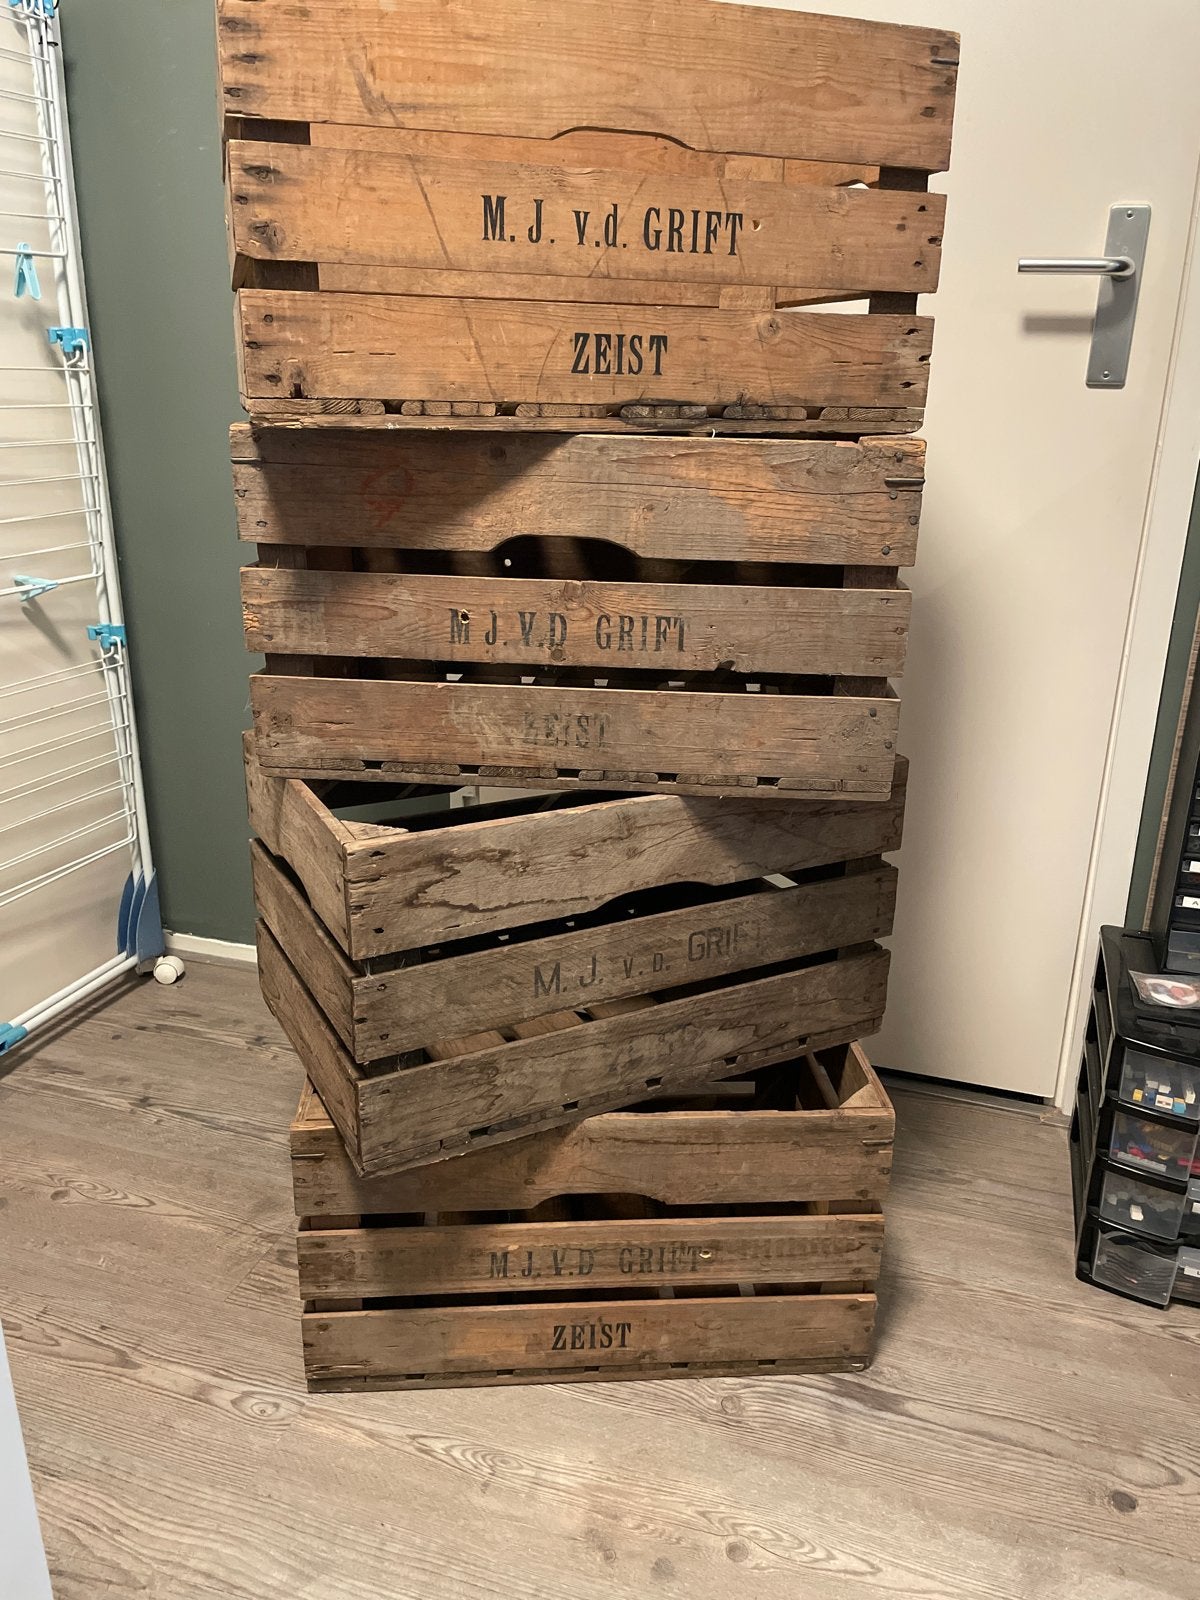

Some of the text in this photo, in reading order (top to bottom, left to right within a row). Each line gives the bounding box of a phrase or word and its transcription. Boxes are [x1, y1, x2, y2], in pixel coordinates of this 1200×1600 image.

[643, 206, 744, 256] GRIFT
[571, 332, 668, 376] ZEIST
[596, 613, 686, 653] GRIFT
[619, 1246, 703, 1274] GRIFT
[552, 1322, 632, 1350] ZEIST
